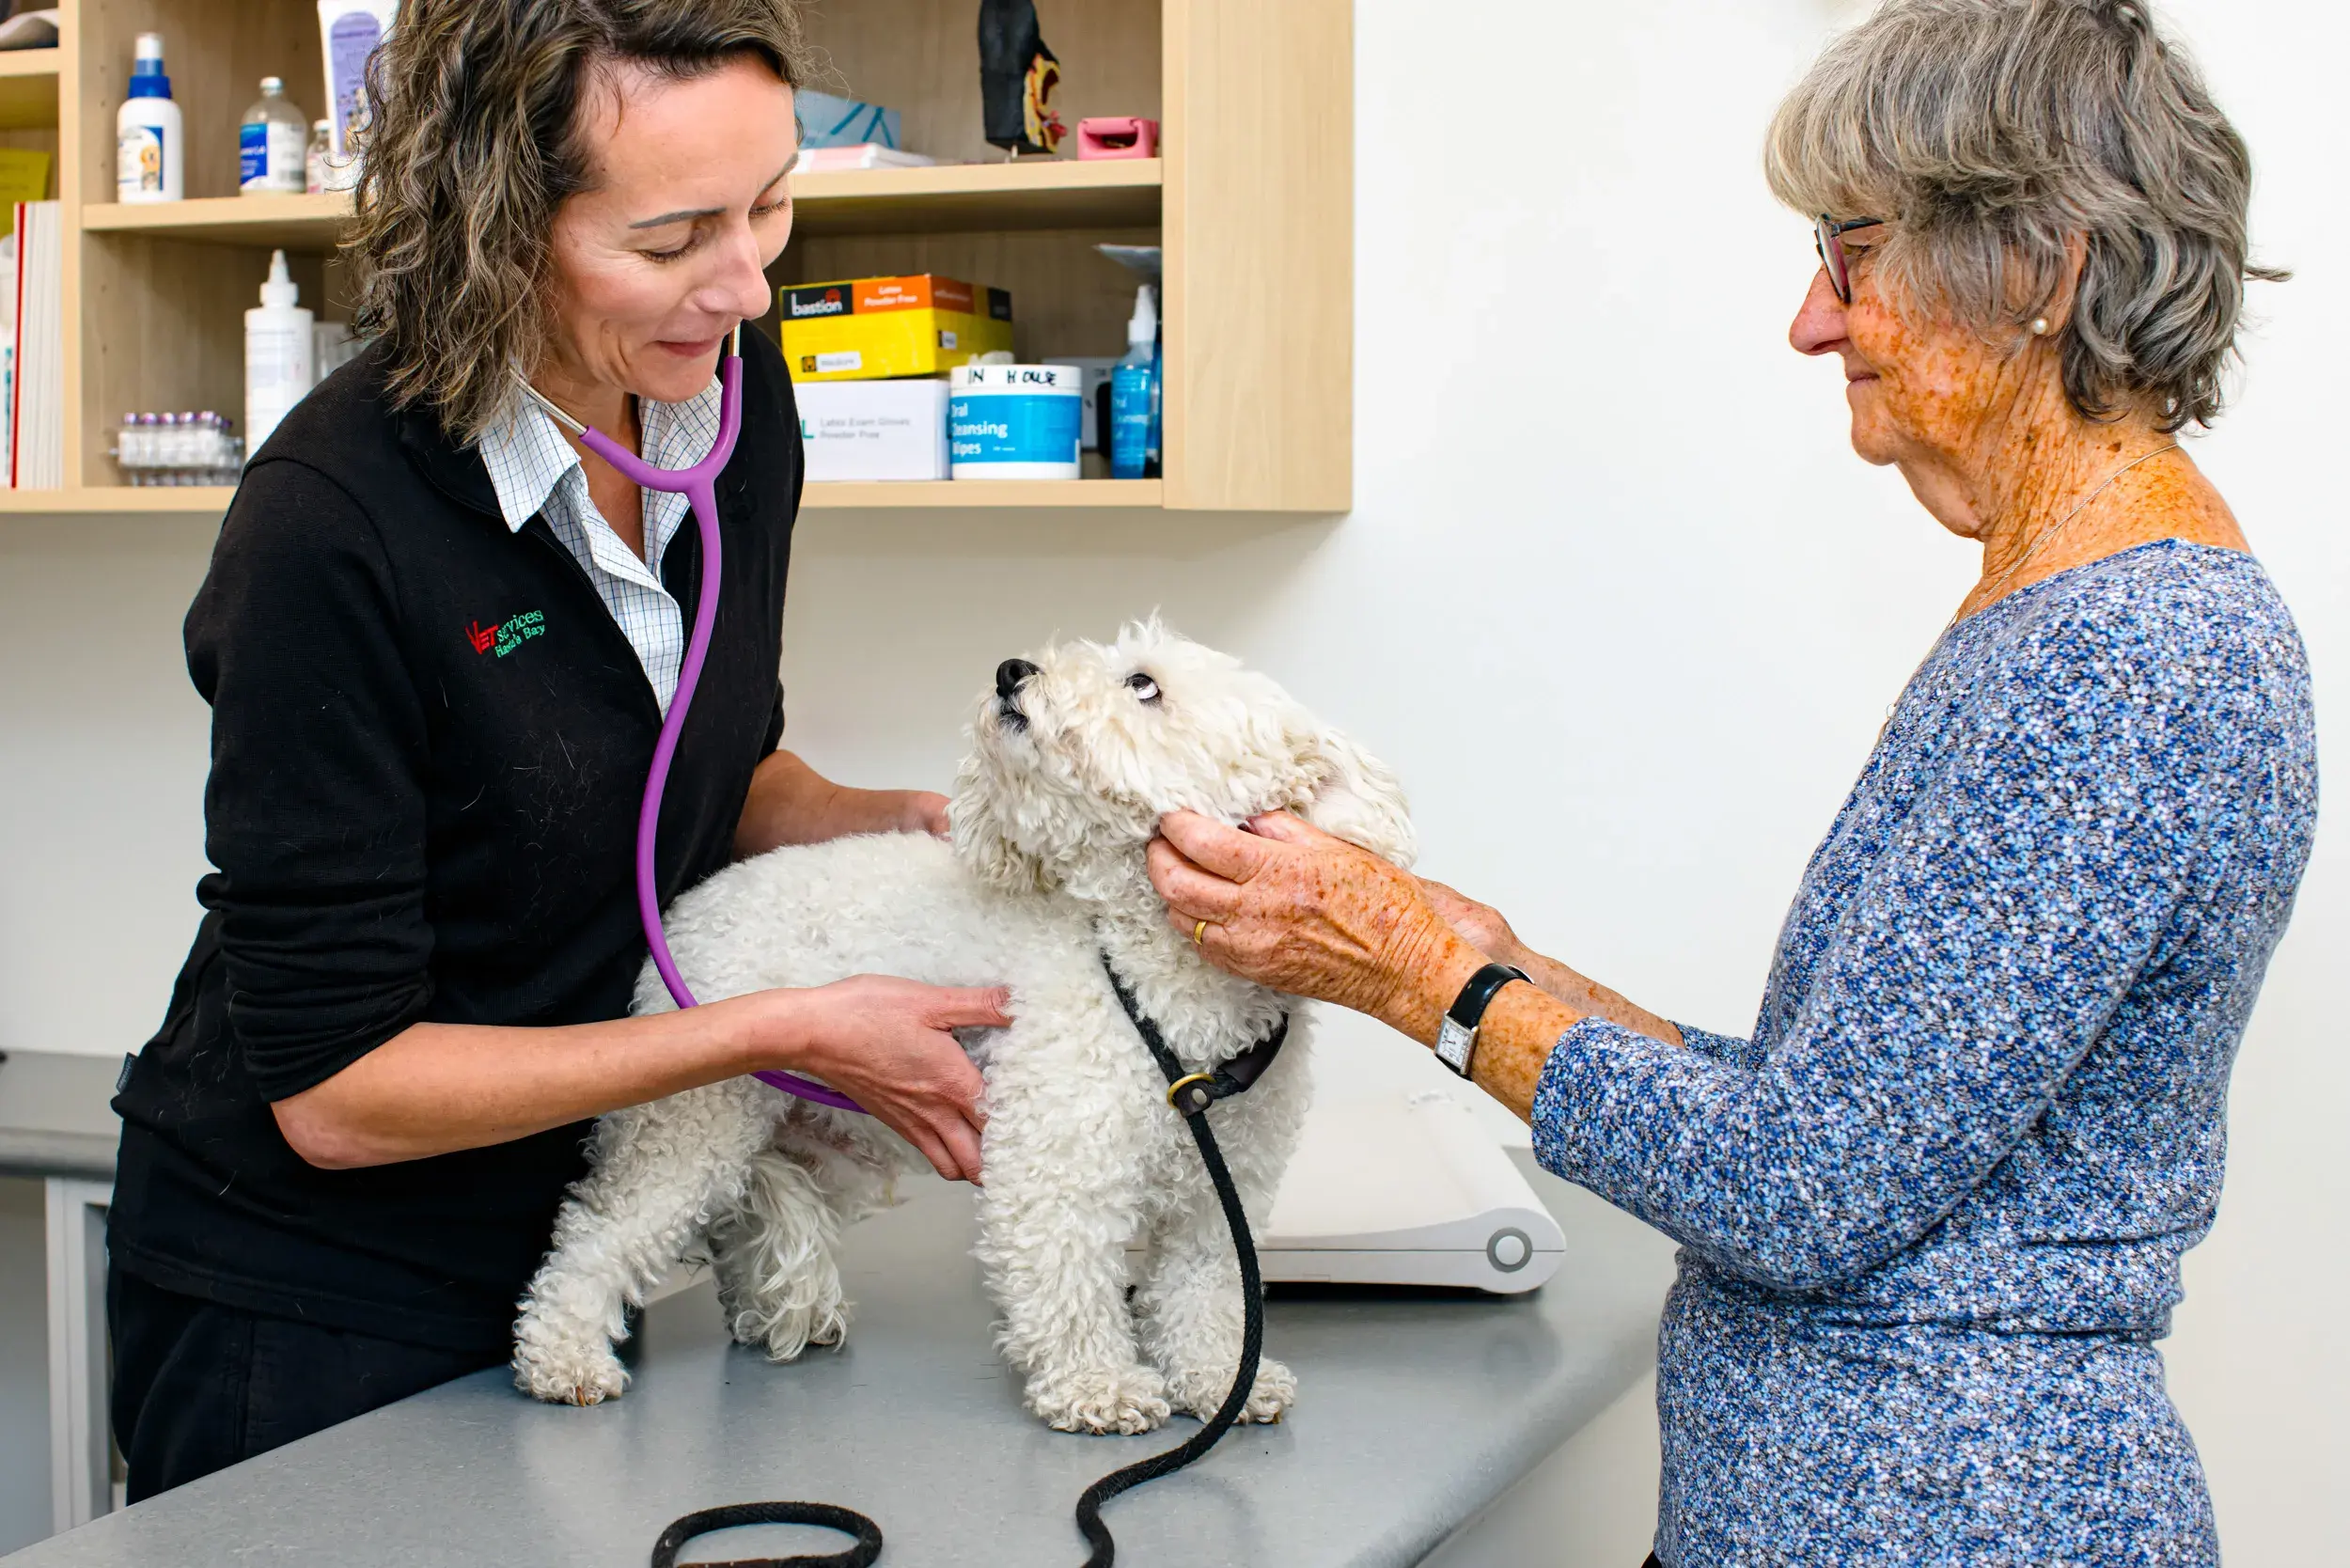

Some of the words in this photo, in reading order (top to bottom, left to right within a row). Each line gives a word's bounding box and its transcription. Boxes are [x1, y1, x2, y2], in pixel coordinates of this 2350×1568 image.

[791, 292, 843, 316] bastion
[968, 368, 984, 384] IN
[820, 417, 846, 428] Latex
[849, 417, 876, 427] Exam
[820, 431, 855, 439] Powder
[859, 431, 880, 439] Free
[464, 620, 499, 655] VET
[523, 625, 545, 639] Bay
